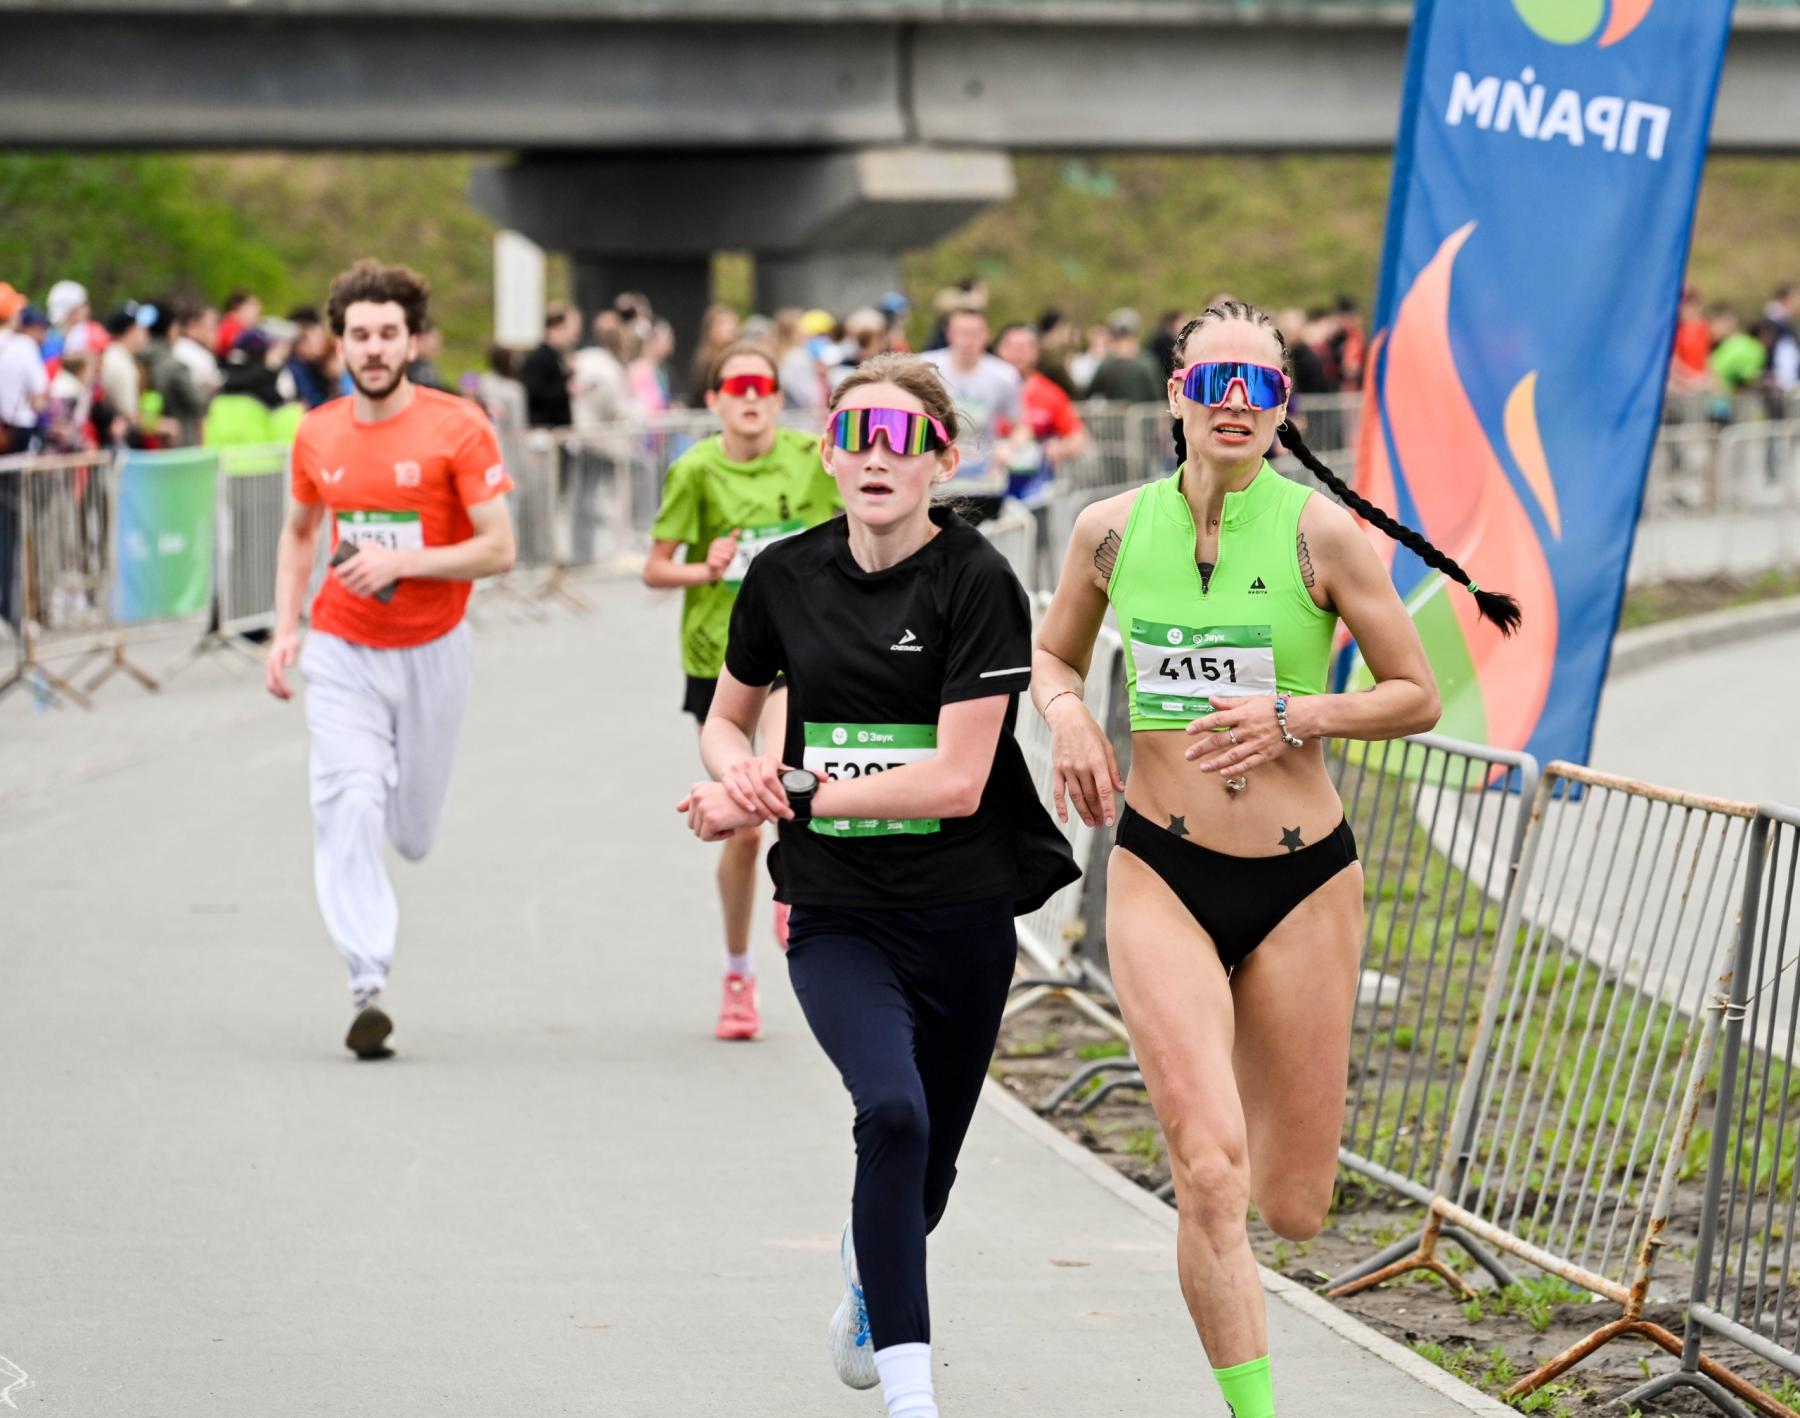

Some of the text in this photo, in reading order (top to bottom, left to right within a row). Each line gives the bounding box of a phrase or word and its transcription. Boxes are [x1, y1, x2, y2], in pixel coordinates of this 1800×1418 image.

[1203, 634, 1225, 642] Звук
[1159, 657, 1236, 683] 4151
[869, 732, 893, 743] Звук
